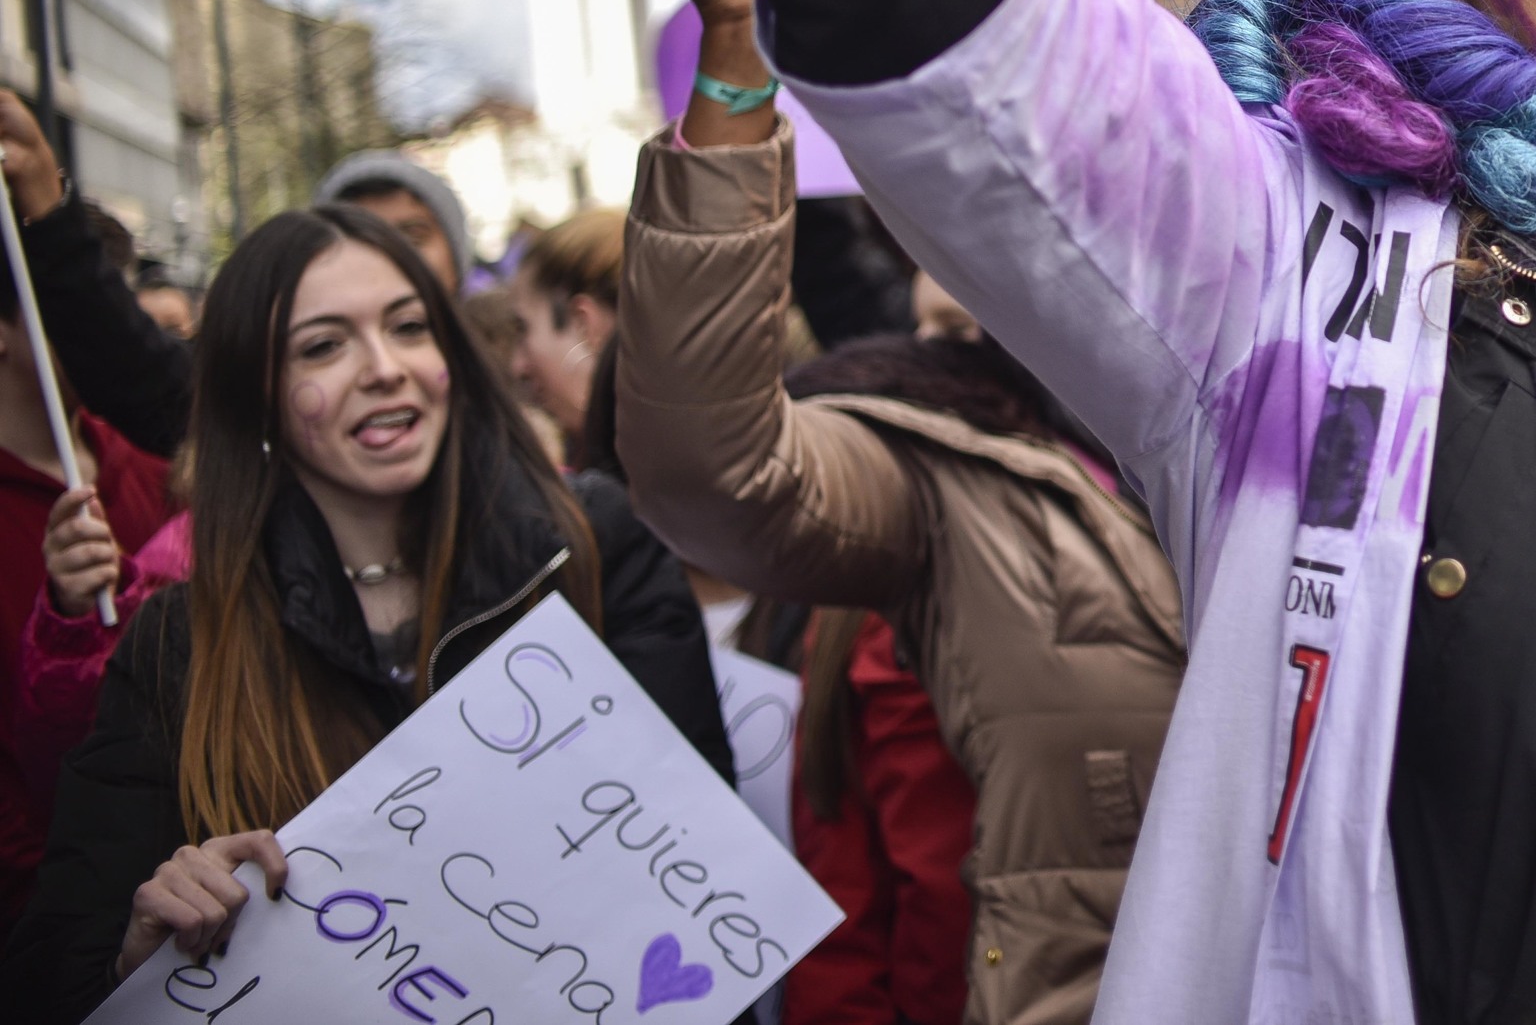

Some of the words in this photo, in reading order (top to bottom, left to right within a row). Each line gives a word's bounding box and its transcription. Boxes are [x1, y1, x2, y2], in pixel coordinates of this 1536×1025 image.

[373, 766, 443, 846] la
[459, 641, 614, 770] Si
[555, 780, 790, 979] quieres
